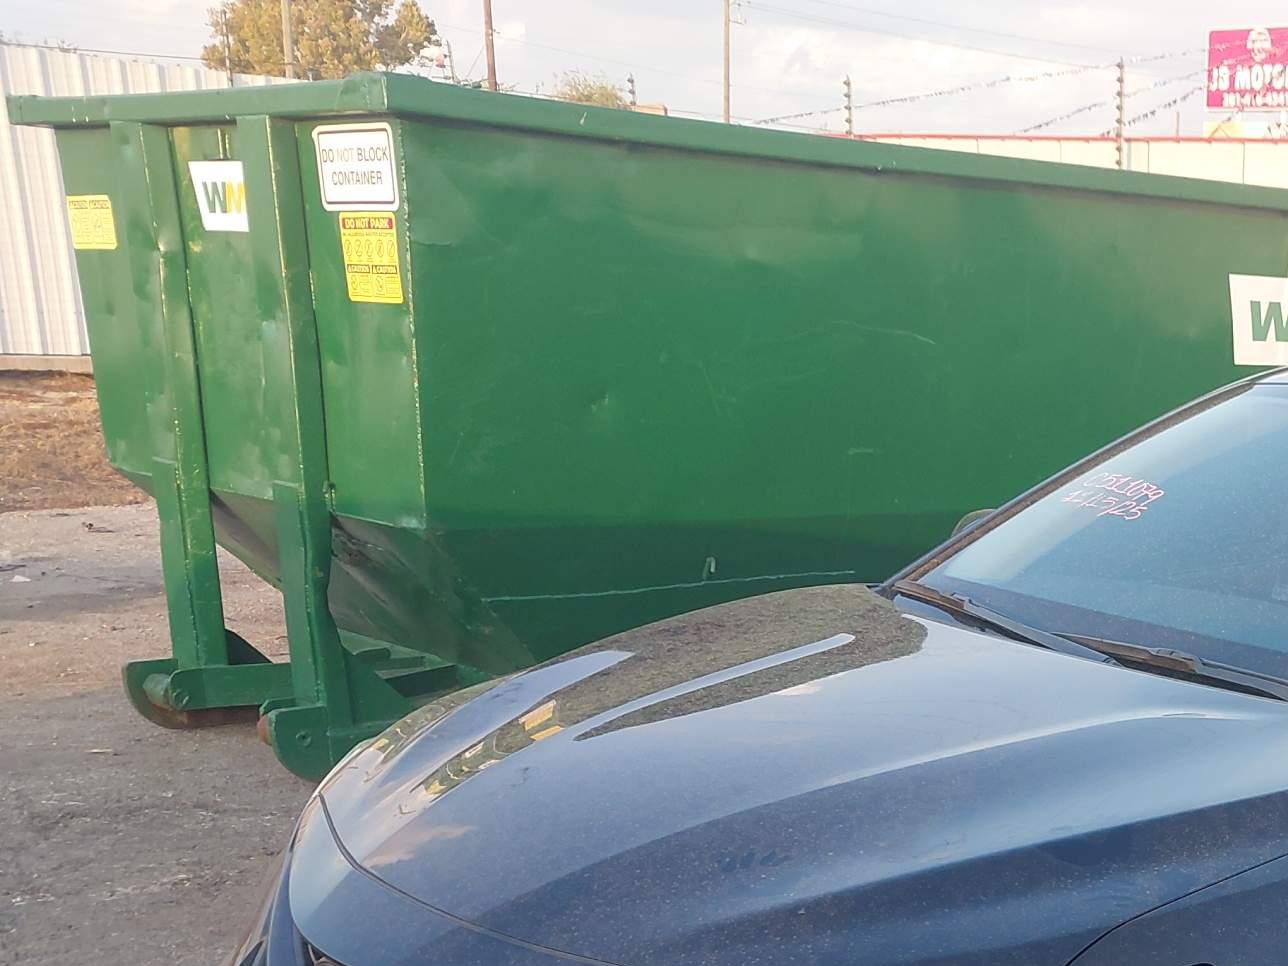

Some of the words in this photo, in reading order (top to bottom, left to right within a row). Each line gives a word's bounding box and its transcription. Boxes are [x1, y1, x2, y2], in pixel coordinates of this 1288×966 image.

[321, 148, 334, 163] DO
[336, 147, 354, 162] NOT
[356, 145, 389, 162] BLOCK
[331, 170, 383, 186] CONTAINER
[202, 181, 246, 214] WM
[345, 218, 355, 229] DO
[356, 218, 369, 229] NOT
[370, 218, 389, 229] PARK
